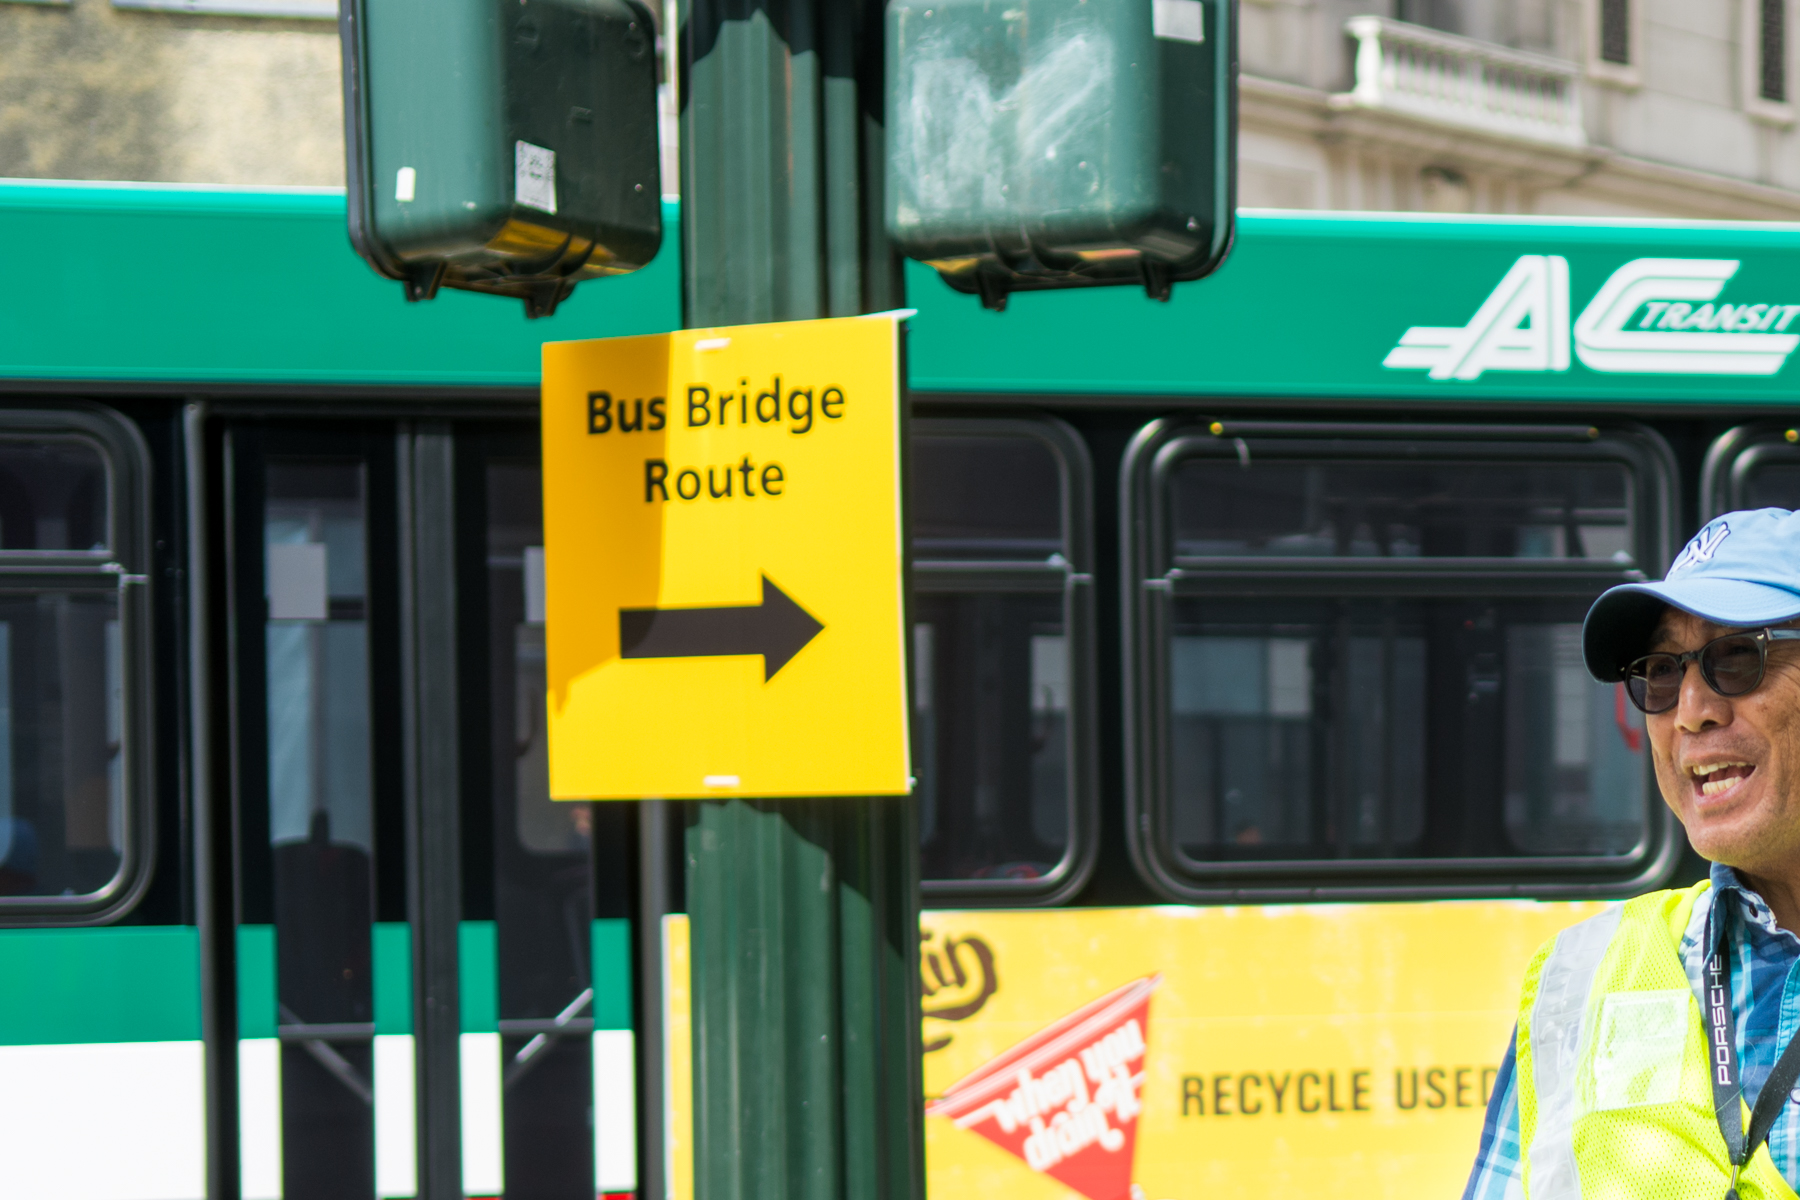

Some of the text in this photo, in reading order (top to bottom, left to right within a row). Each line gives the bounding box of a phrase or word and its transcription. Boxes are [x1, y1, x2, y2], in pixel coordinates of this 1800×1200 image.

[1382, 254, 1800, 381] AC
[587, 376, 845, 435] Bus Bridge
[645, 456, 784, 502] Route
[1709, 954, 1732, 1085] PORSCHE
[954, 1018, 1146, 1133] when you
[1182, 1067, 1371, 1117] RECYCLE
[1023, 1102, 1126, 1172] drain
